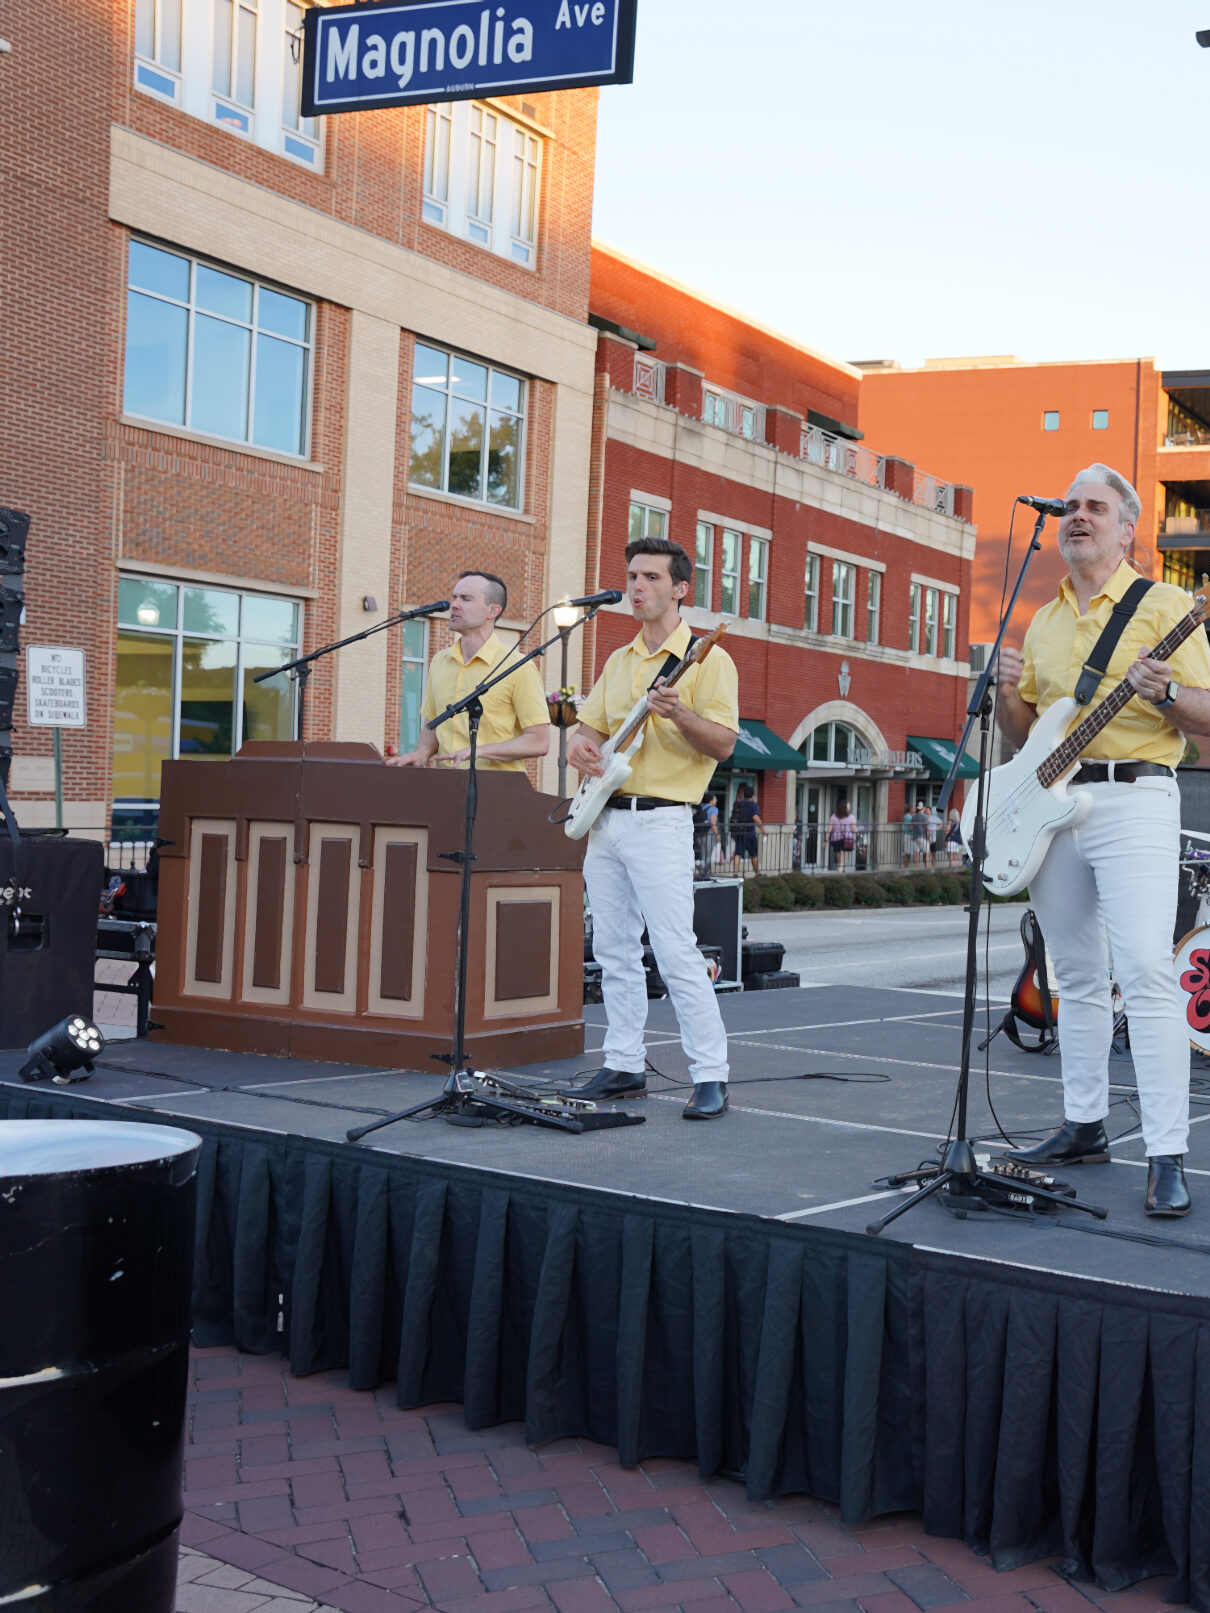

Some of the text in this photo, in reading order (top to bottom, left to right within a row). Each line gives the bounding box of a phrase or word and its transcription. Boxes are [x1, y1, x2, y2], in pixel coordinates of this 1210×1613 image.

[326, 0, 606, 89] Magnolia Ave
[445, 82, 475, 93] AUBURN
[51, 655, 62, 663] NO
[41, 665, 72, 675] BICYCLES
[32, 676, 81, 687] ROLLER BLADES
[41, 688, 73, 697] SCOOTERS
[35, 699, 80, 709] SKATEBOARDS
[36, 710, 80, 720] ON SIDEWALK
